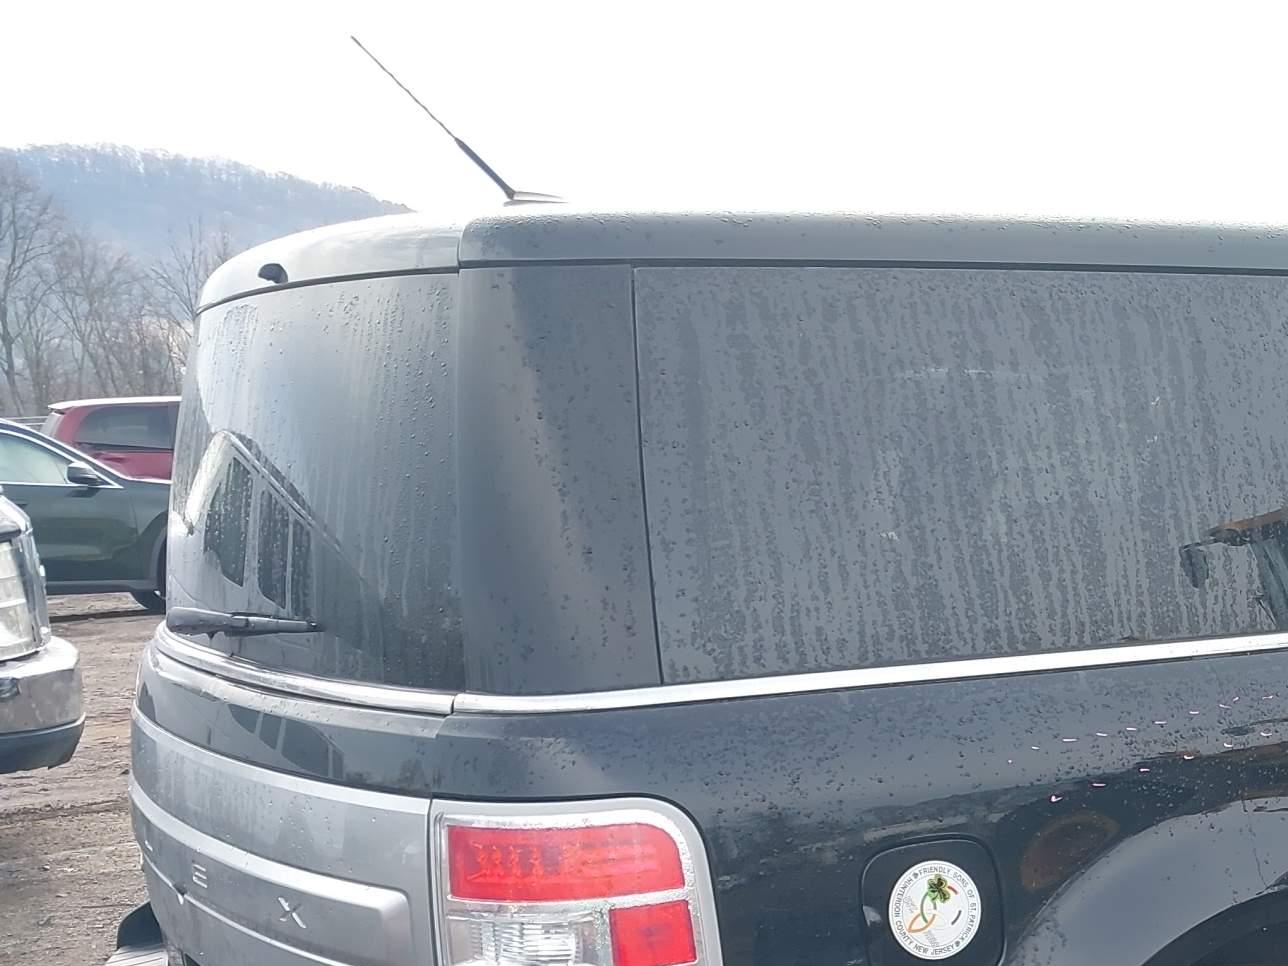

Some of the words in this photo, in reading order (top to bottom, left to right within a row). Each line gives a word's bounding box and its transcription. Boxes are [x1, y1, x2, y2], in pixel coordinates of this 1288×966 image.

[918, 866, 951, 875] FRIENDLY
[952, 871, 969, 888] SONS
[967, 889, 975, 899] OF
[959, 914, 976, 942] PATRICK
[895, 920, 913, 945] COUNTY
[913, 943, 929, 954] NEW
[930, 943, 955, 956] JERSEY
